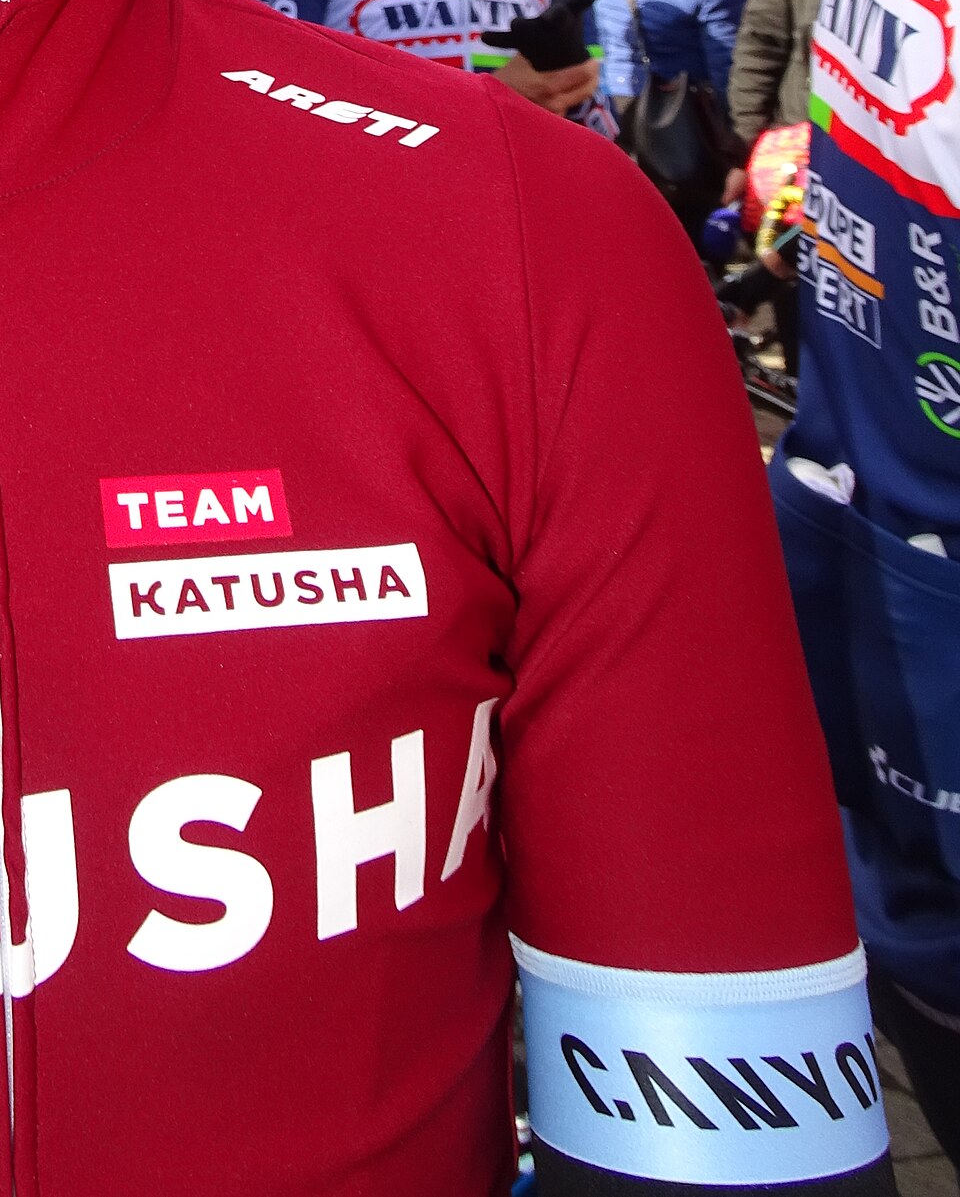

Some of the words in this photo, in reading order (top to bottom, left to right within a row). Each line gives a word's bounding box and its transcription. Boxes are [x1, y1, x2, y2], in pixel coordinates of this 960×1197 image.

[220, 69, 440, 148] ARETI
[117, 485, 274, 530] TEAM
[128, 565, 412, 618] KATUSHA
